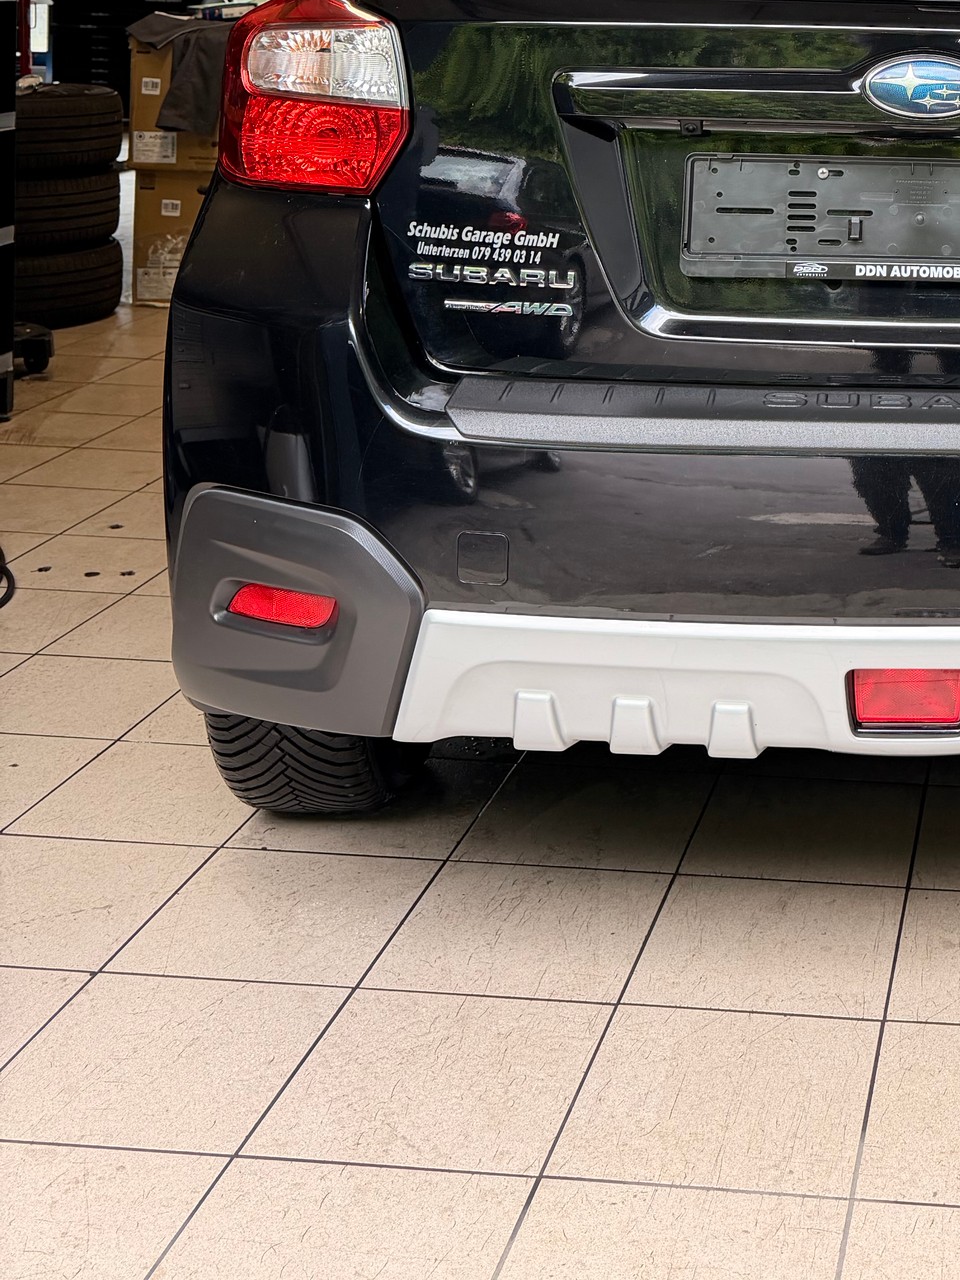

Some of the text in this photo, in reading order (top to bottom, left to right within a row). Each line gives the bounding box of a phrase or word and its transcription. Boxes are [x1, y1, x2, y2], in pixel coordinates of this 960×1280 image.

[407, 221, 560, 249] Schubis Garage GmbH
[416, 241, 542, 265] Unterterzen 079 439 03 14
[408, 263, 577, 289] SUBARU
[855, 264, 890, 277] DDN
[491, 301, 574, 317] AWD
